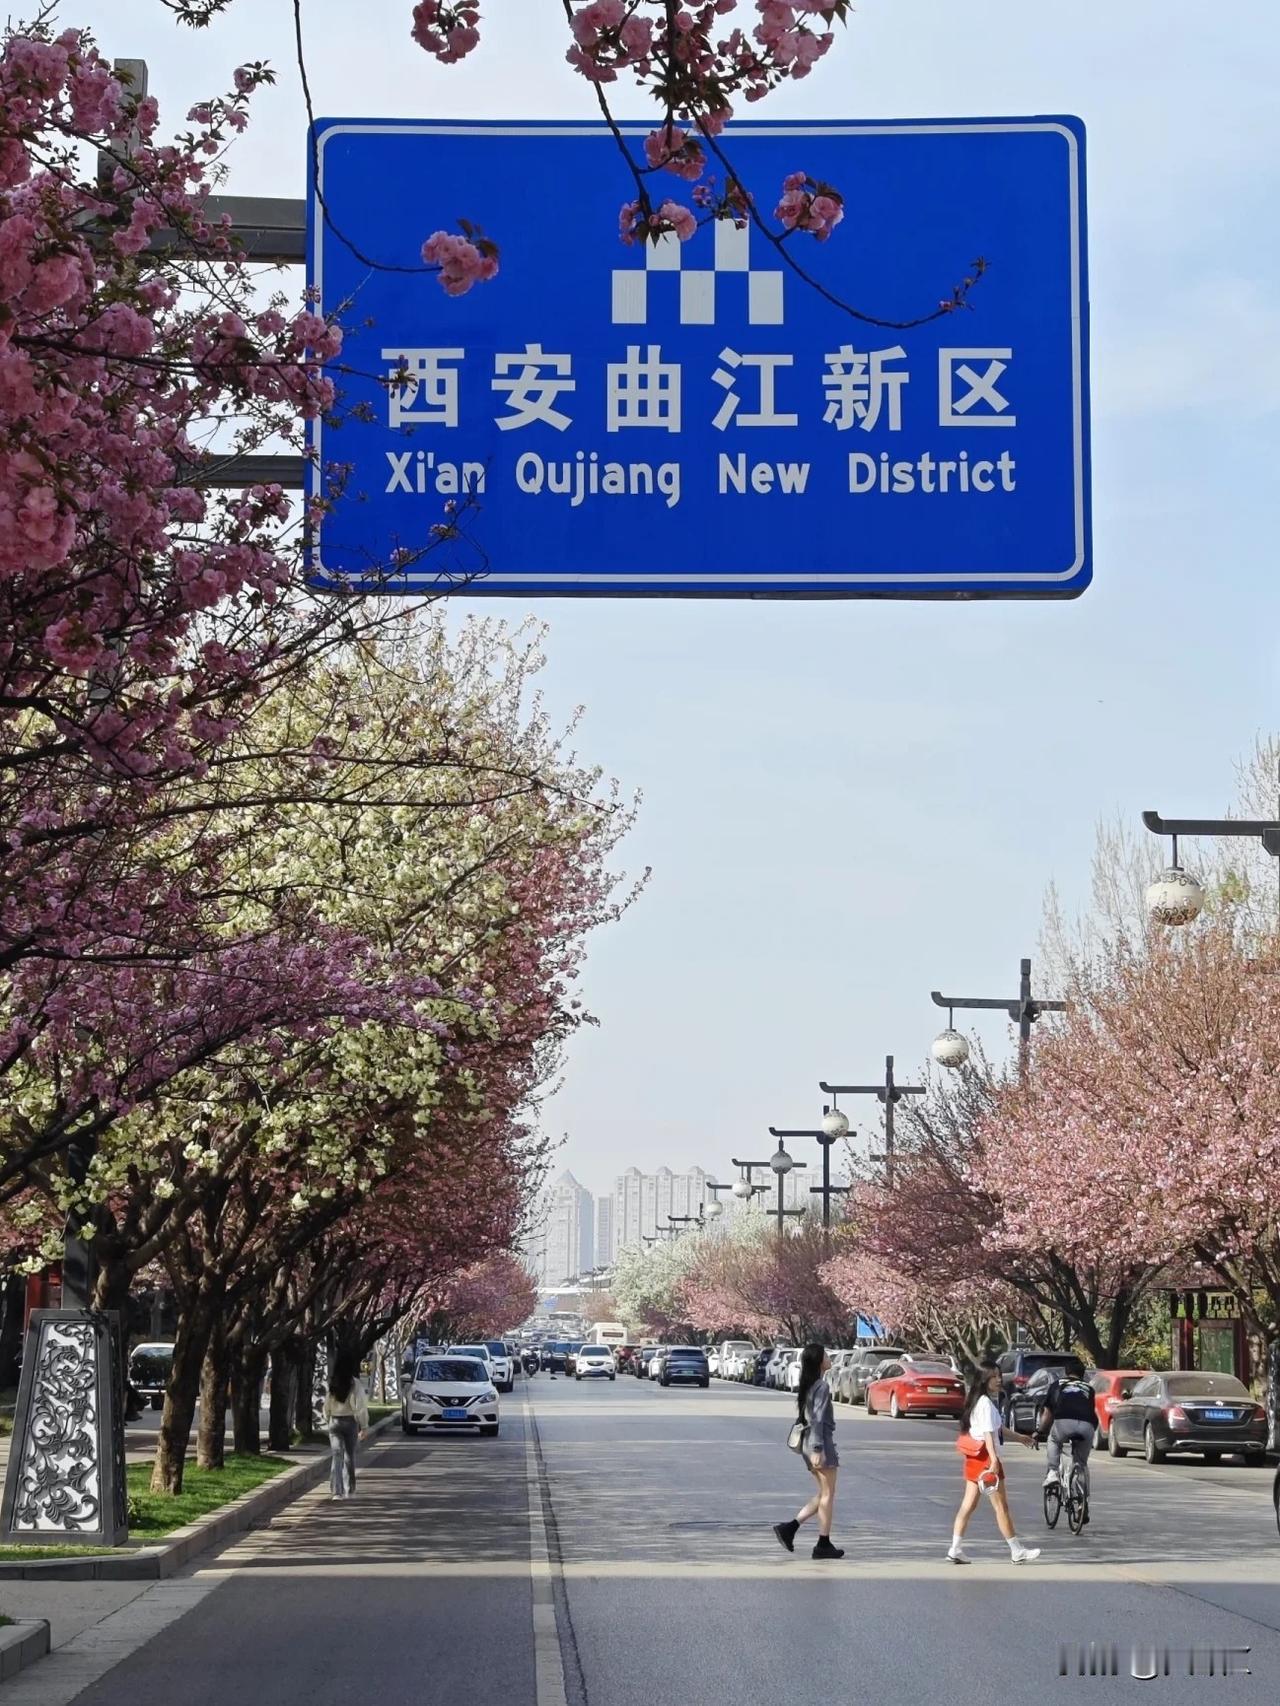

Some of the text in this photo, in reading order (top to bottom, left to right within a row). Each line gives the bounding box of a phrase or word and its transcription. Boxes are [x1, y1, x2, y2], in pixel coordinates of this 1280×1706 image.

[380, 343, 1017, 433] 西安曲江新区
[385, 450, 1016, 508] Xi'an Qujiang New District
